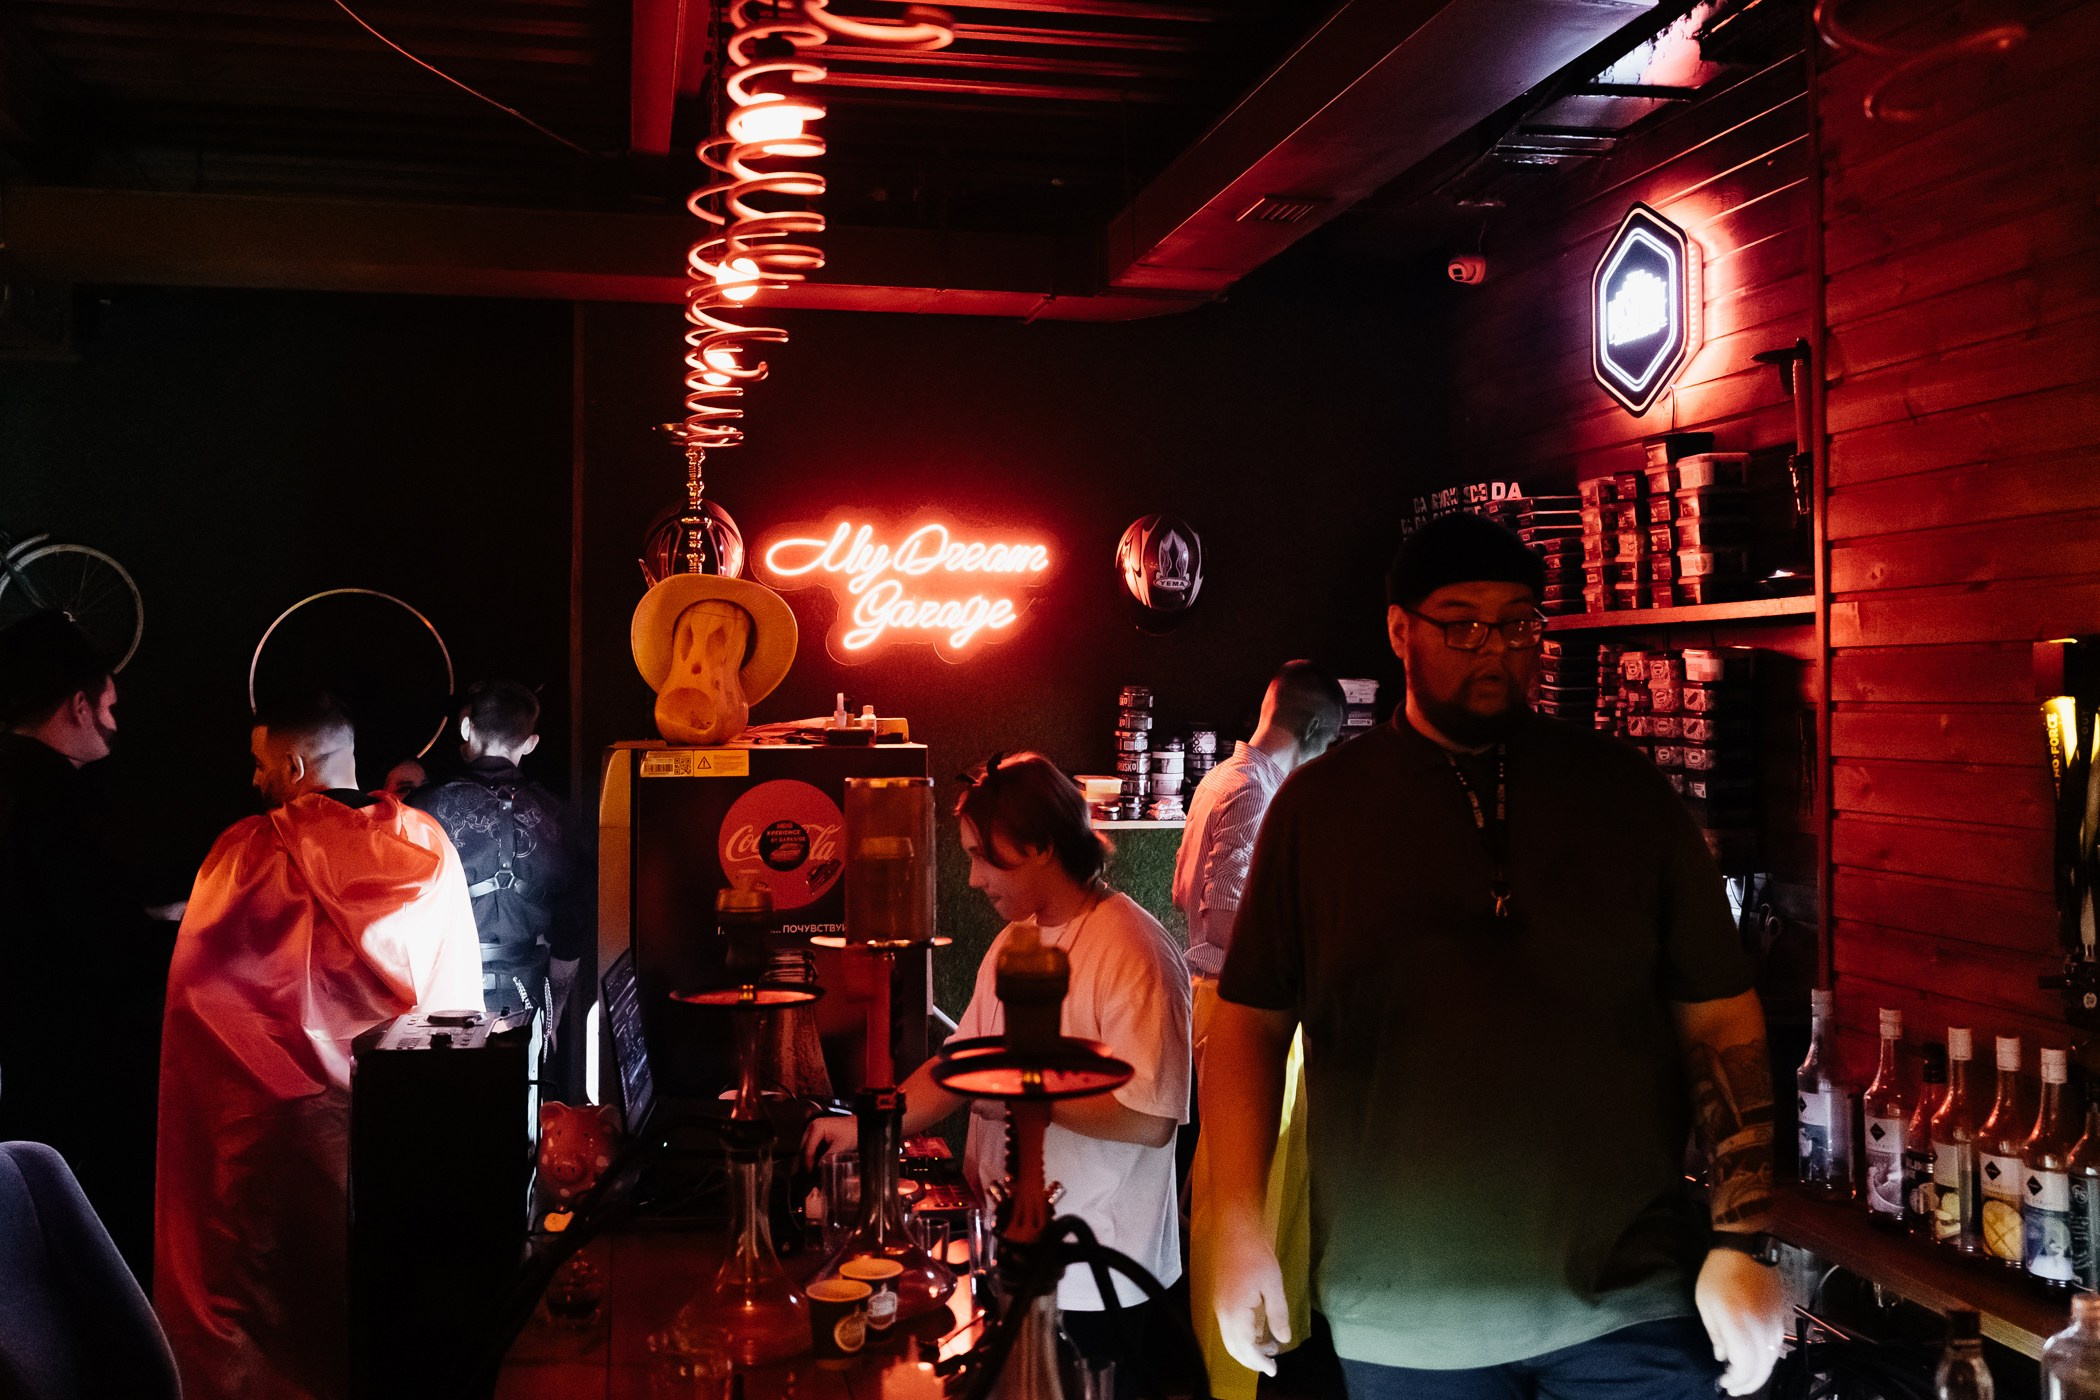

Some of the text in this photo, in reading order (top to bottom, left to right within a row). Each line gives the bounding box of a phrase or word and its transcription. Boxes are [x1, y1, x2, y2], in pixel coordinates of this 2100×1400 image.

[765, 521, 1049, 594] My Dream
[842, 579, 1017, 650] Garage
